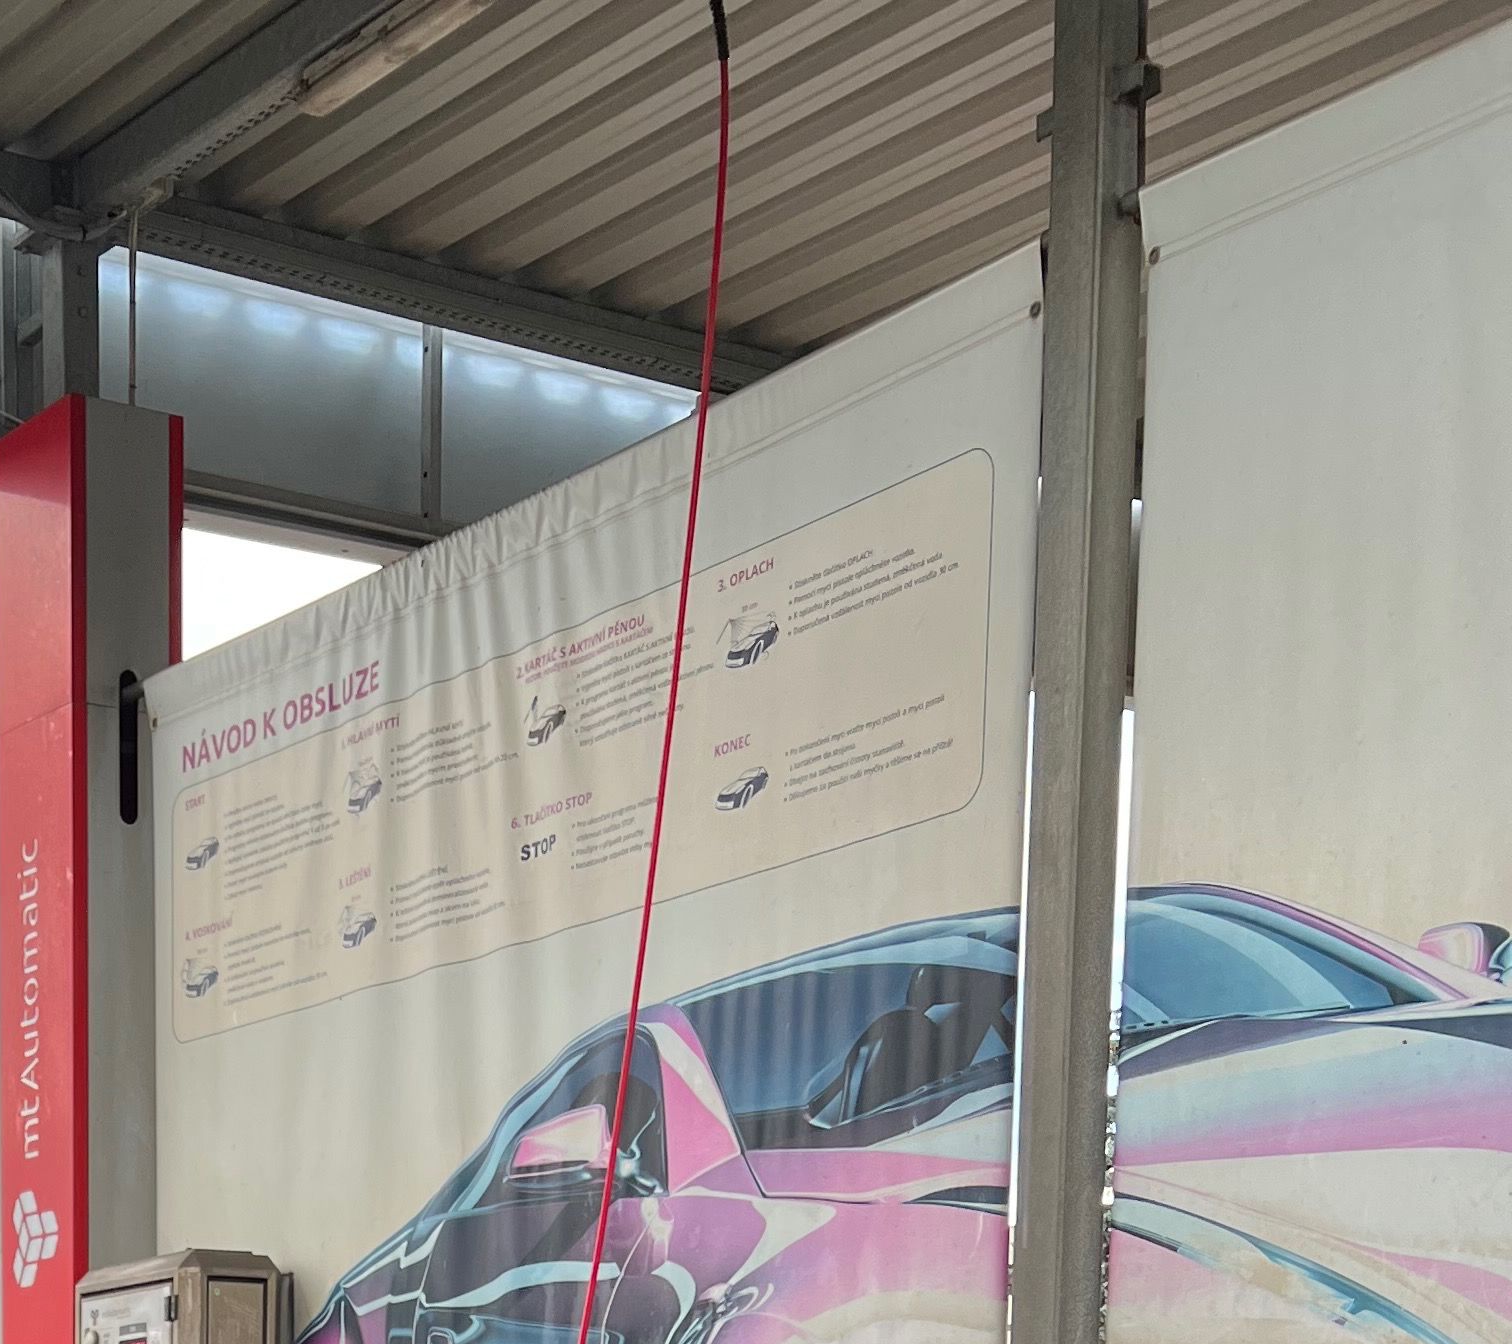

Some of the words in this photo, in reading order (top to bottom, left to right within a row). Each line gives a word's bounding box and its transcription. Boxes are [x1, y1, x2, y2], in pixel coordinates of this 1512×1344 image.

[730, 557, 775, 587] OPLACH
[559, 647, 567, 658] S
[182, 719, 257, 773] NÁVOD
[263, 708, 277, 739] K
[283, 660, 380, 730] OBSLUZE
[713, 733, 752, 758] KONEC
[565, 792, 593, 811] STOP
[521, 834, 557, 861] STOP
